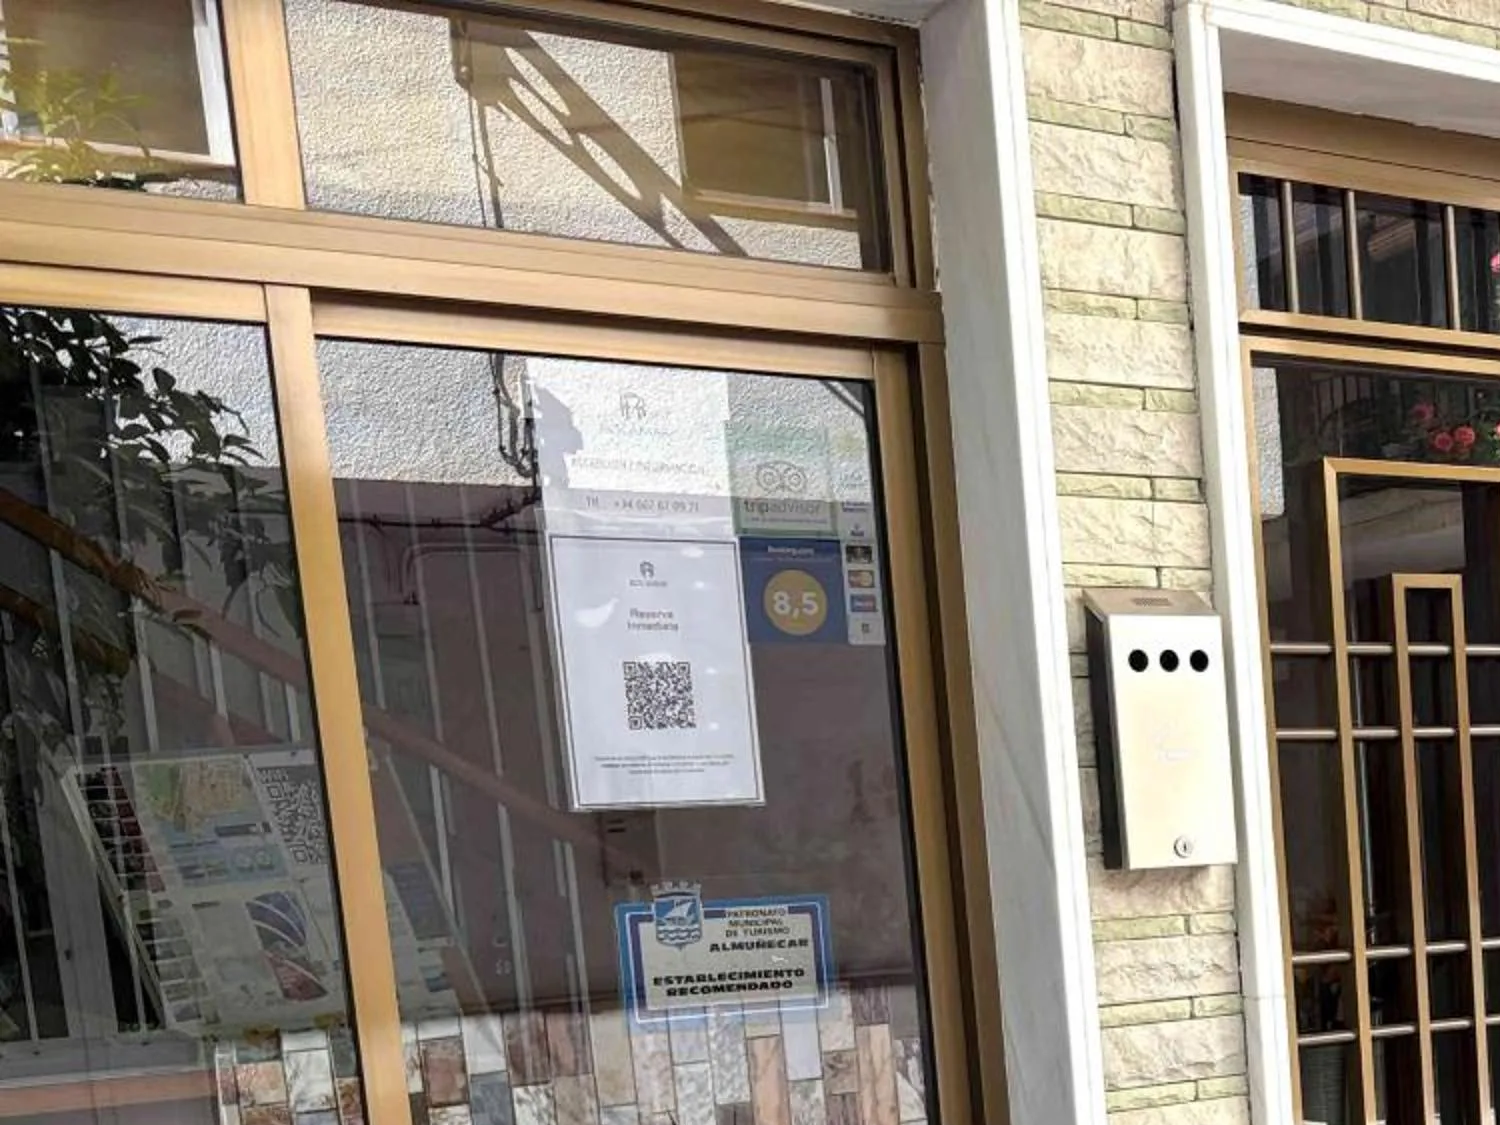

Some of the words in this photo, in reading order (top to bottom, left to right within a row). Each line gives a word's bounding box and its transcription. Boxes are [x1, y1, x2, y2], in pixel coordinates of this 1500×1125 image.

[772, 591, 819, 619] 8,5
[728, 917, 783, 927] MUNICIPAL
[725, 929, 738, 938] DE
[743, 926, 790, 937] TURISMO
[653, 967, 805, 986] ESTABLECIMIENTO
[666, 980, 793, 997] RECOMENDADO
